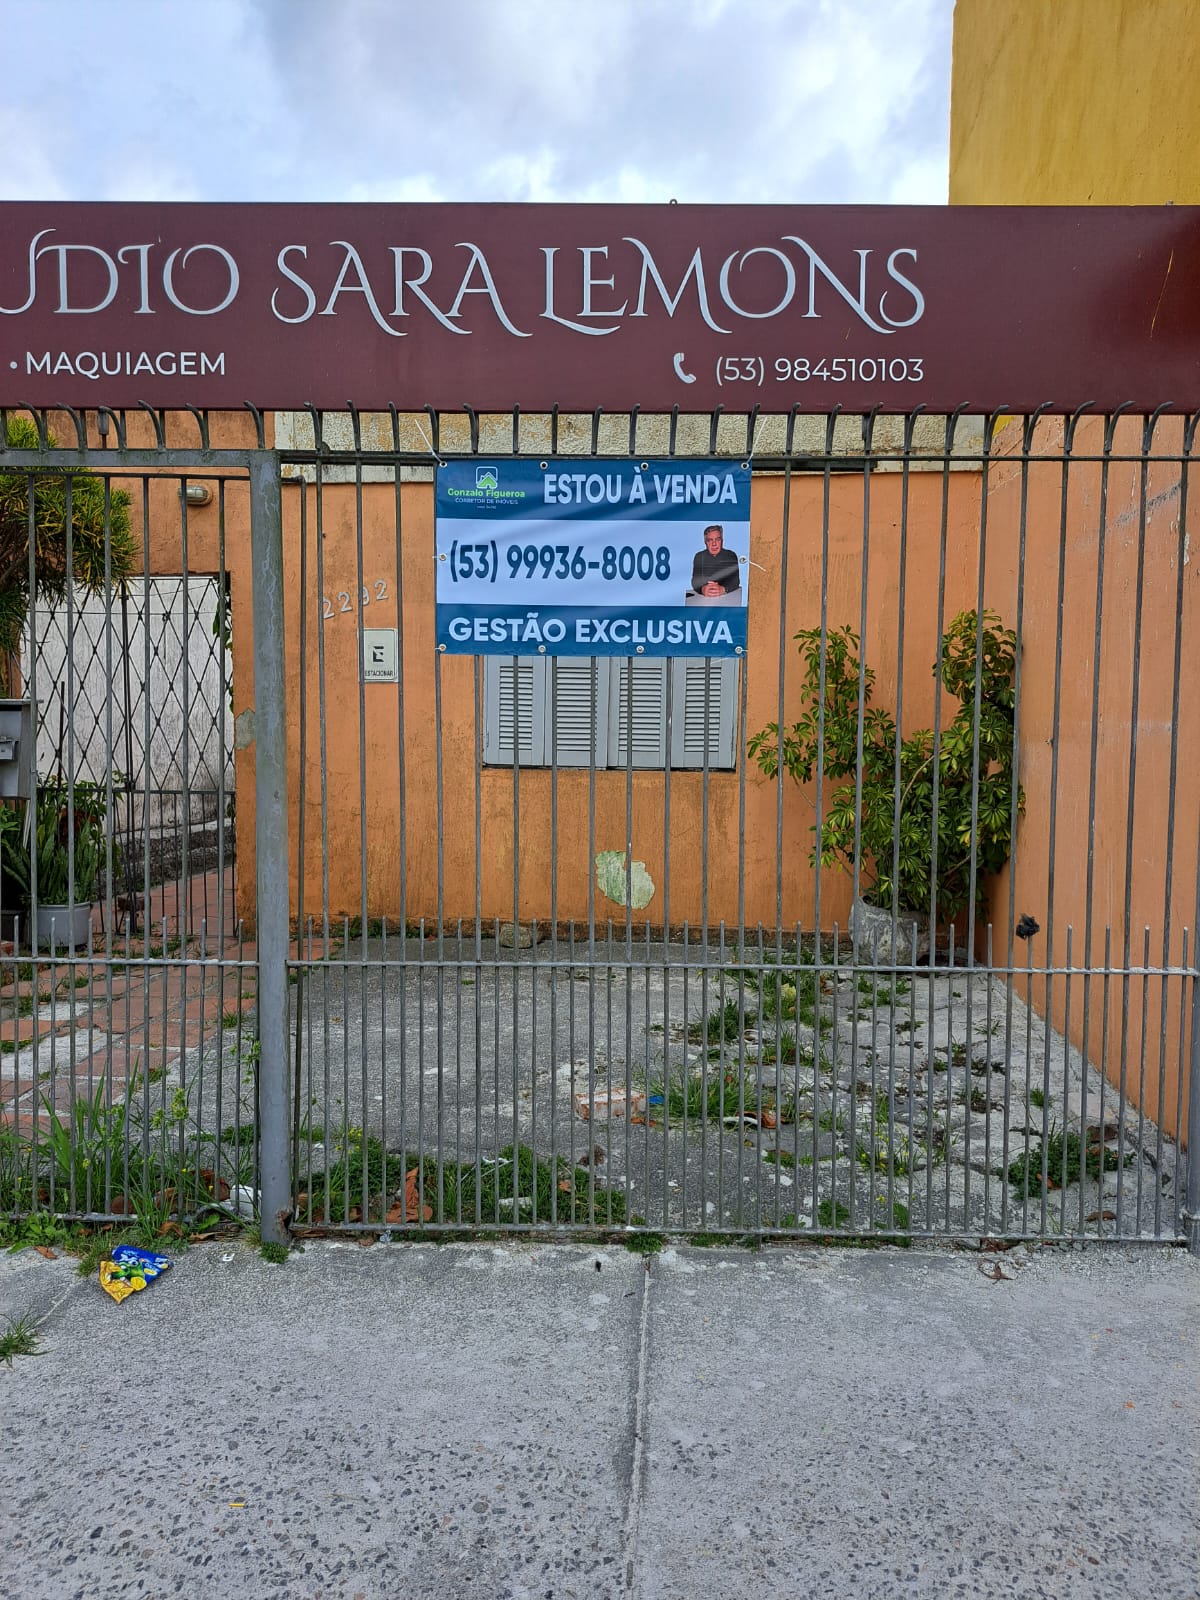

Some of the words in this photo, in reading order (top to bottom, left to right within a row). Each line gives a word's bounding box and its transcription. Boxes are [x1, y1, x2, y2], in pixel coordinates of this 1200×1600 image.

[271, 240, 533, 338] SARA
[538, 235, 926, 335] LEMONS
[26, 351, 226, 380] MAQUIAGEM
[715, 355, 765, 386] (53)
[774, 357, 925, 383] 984510103
[447, 488, 484, 497] Gonzalo
[486, 488, 526, 499] Figueroa
[543, 473, 622, 505] ESTOU
[629, 466, 647, 505] À
[653, 474, 738, 505] VENDA
[450, 540, 498, 583] (53)
[506, 544, 671, 581] 99936-8008
[448, 612, 567, 643] GESTÃO
[574, 618, 734, 645] EXCLUSIVA
